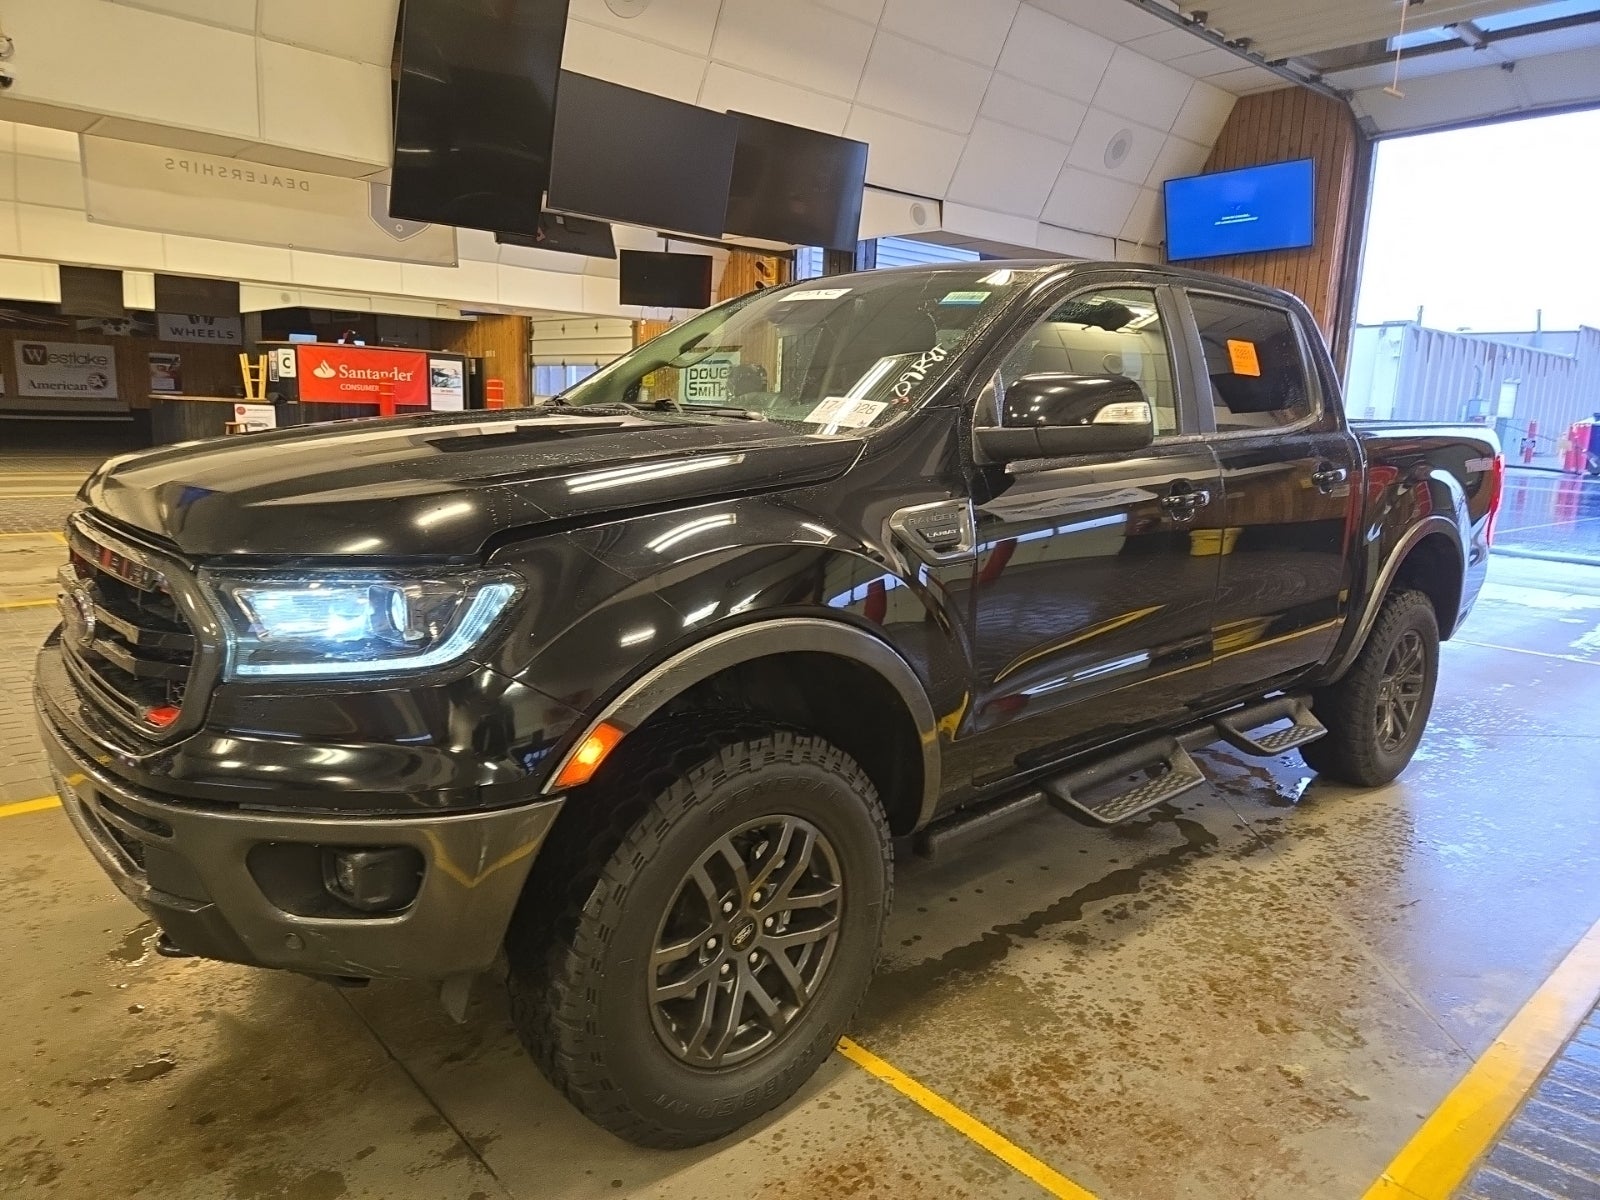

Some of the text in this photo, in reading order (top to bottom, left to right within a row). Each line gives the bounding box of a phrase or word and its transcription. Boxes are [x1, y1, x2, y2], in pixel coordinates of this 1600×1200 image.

[170, 327, 234, 339] WHEELS
[24, 348, 107, 366] Westlake
[282, 357, 291, 369] C
[338, 364, 414, 382] Santander
[689, 367, 728, 380] DOUG
[29, 380, 88, 391] American
[340, 383, 380, 392] CONSUMER
[908, 513, 958, 526] RANGER
[926, 528, 958, 538] LARIAT
